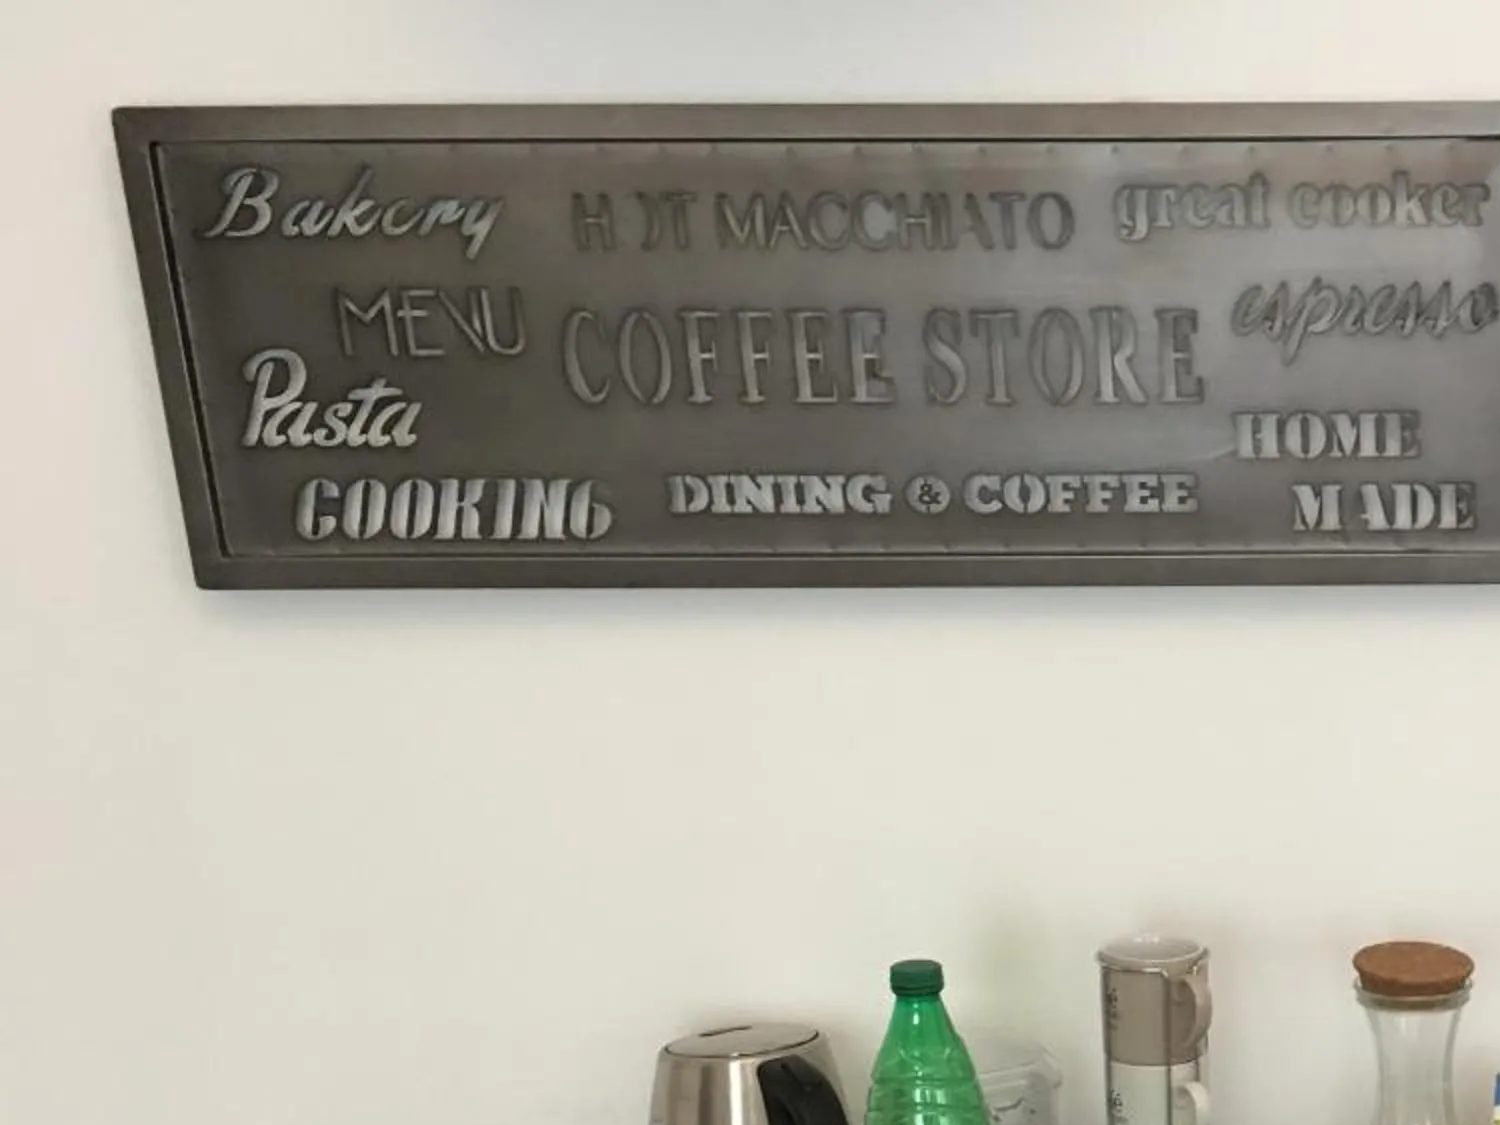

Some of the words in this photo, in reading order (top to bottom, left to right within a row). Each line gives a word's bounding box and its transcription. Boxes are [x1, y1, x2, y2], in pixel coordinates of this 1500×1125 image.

[203, 165, 504, 259] Bakery
[717, 190, 1076, 251] MACCHIATO
[1113, 171, 1271, 242] great
[1286, 170, 1491, 229] cooker
[334, 286, 526, 357] MENU
[562, 308, 896, 406] COFFEE
[922, 306, 1205, 405] STORE
[242, 348, 420, 448] Pasta
[1232, 409, 1420, 459] HOME
[298, 475, 614, 541] COOKING
[668, 474, 892, 515] DINING
[909, 475, 951, 515] &
[963, 472, 1199, 514] COFFEE
[1292, 482, 1475, 532] MADE
